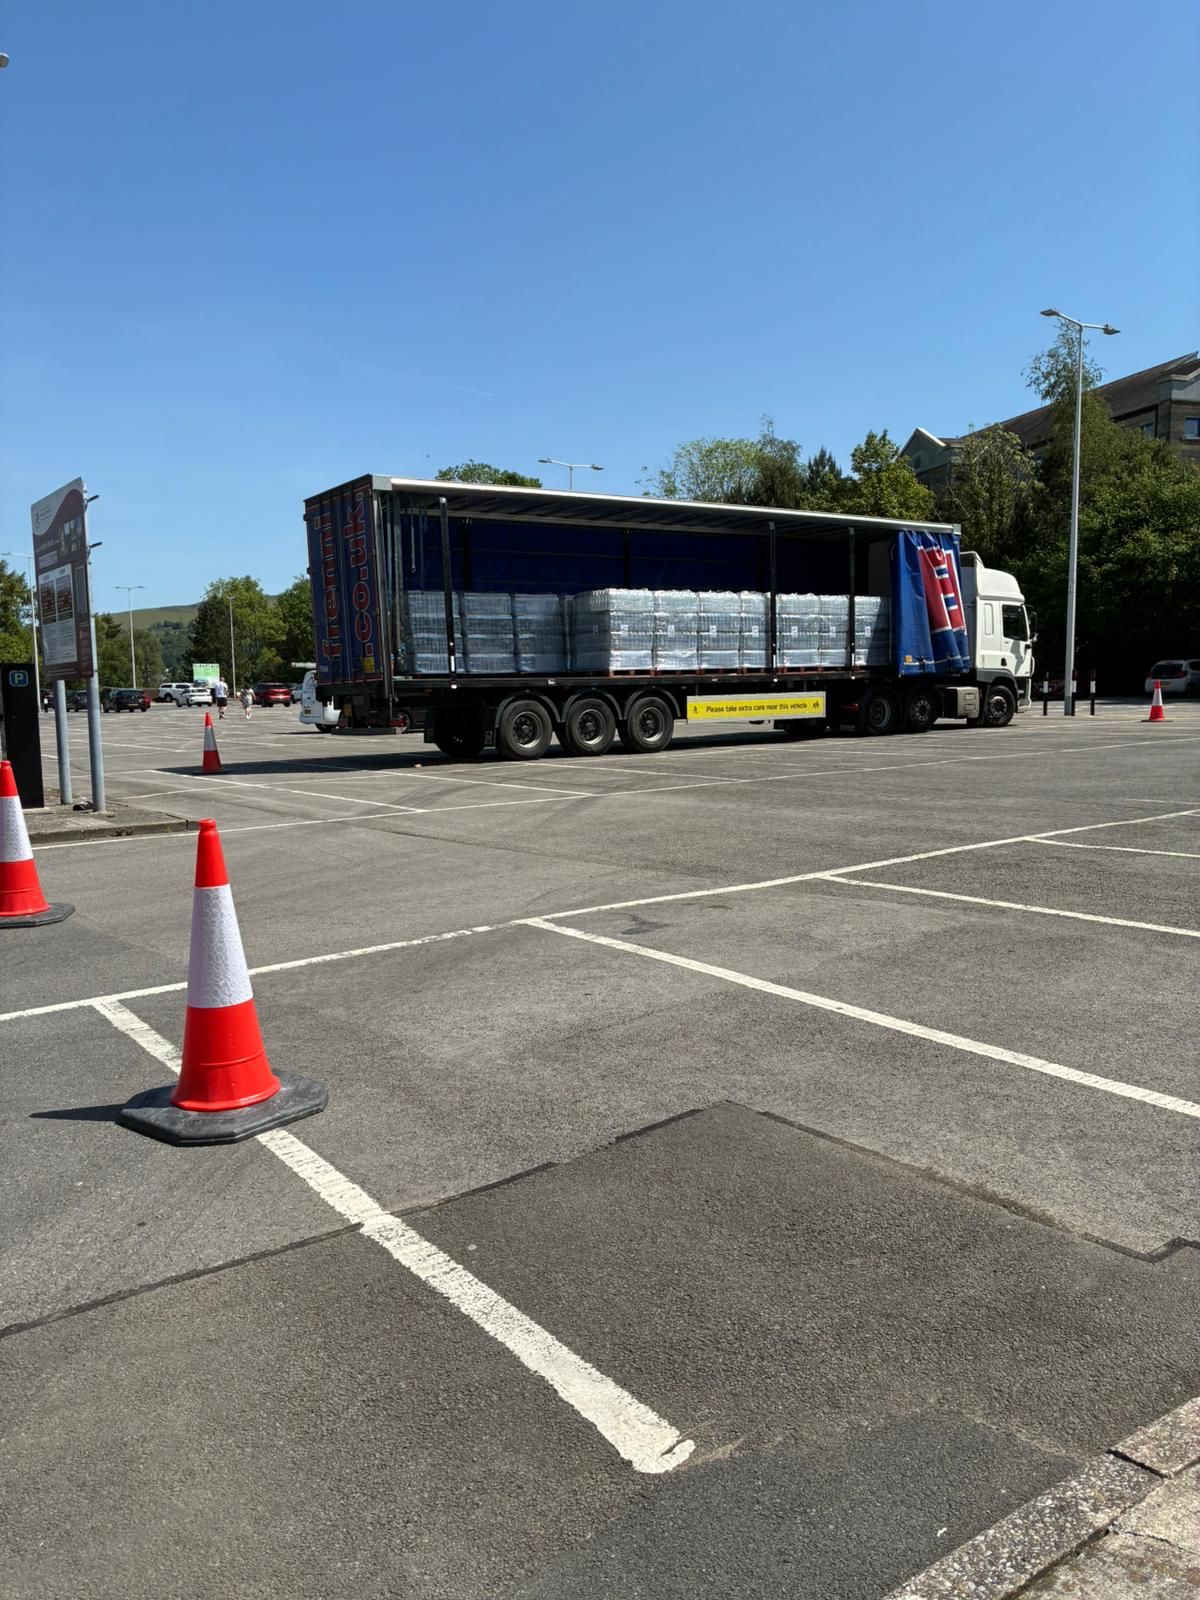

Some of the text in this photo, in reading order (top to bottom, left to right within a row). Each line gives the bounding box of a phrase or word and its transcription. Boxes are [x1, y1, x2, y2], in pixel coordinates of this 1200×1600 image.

[314, 512, 342, 657] frenni
[343, 506, 373, 657] .co.uk
[14, 673, 25, 685] P
[706, 705, 724, 713] Please
[725, 704, 737, 712] take
[738, 704, 752, 712] extra
[779, 702, 789, 710] this
